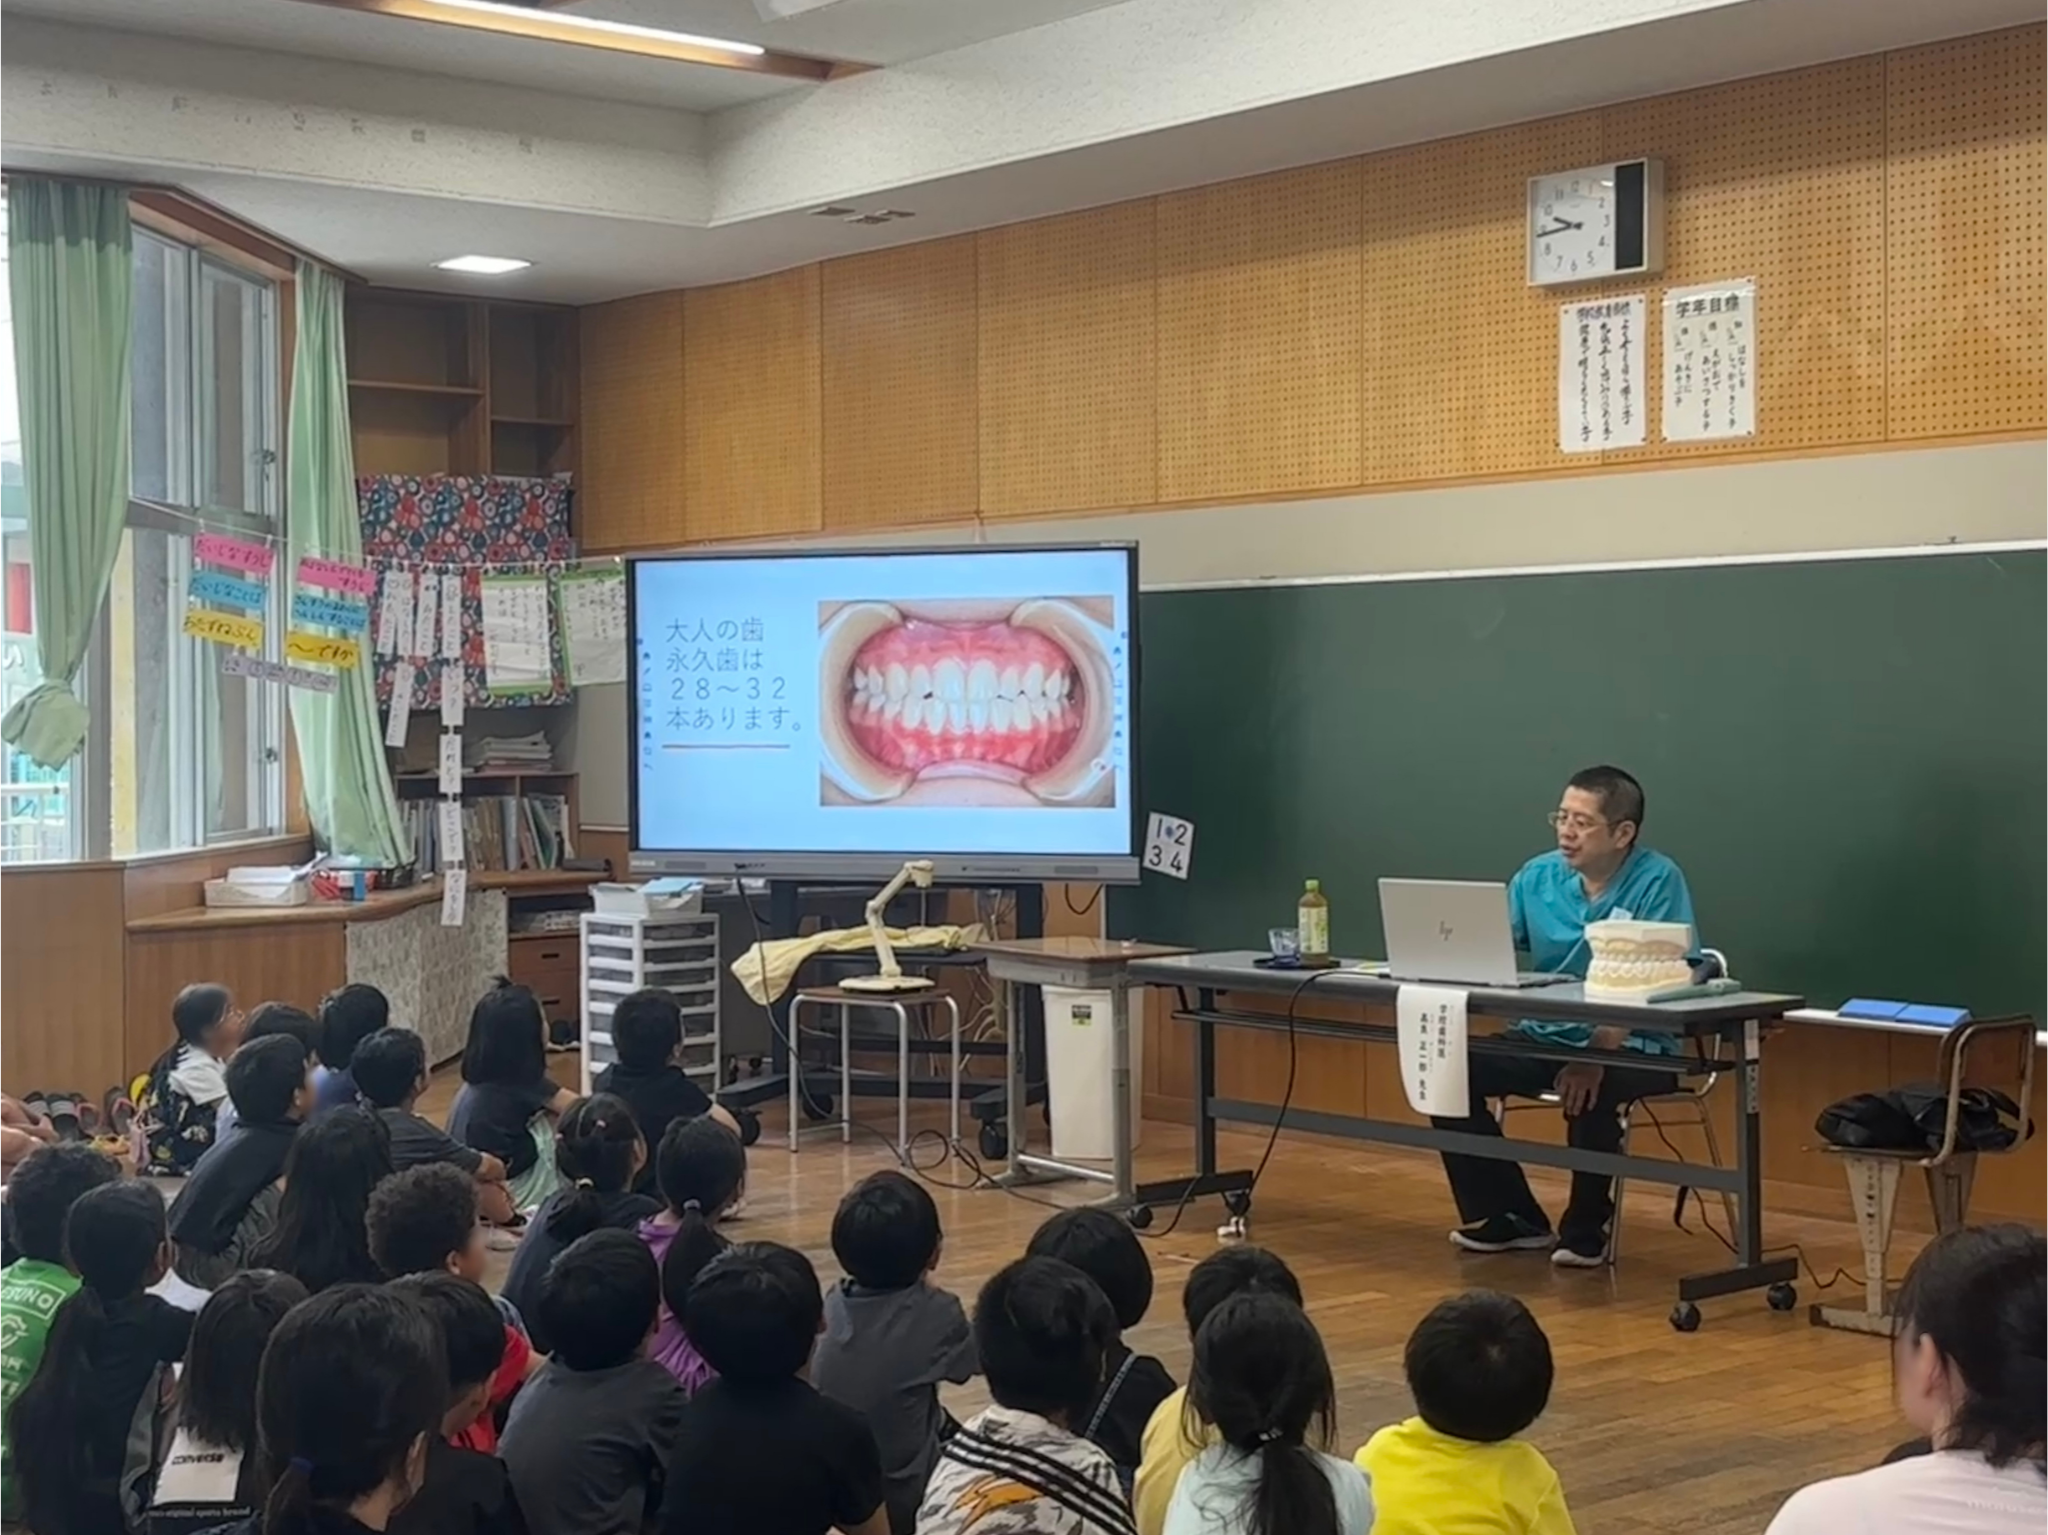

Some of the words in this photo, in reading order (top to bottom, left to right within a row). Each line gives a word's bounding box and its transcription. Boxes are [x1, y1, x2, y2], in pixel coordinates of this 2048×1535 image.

[1555, 187, 1564, 201] 11
[1570, 180, 1580, 193] 12
[1598, 197, 1606, 209] 2
[1603, 214, 1610, 227] 3
[1543, 243, 1552, 256] 8
[1598, 236, 1606, 247] 4
[1556, 256, 1564, 268] 7
[1570, 258, 1578, 272] 6
[1587, 250, 1595, 264] 5
[1675, 292, 1740, 318] 学年目標
[1702, 355, 1712, 431] あいさつする子
[665, 616, 764, 643] 大人の歯
[666, 647, 763, 673] 永久歯は
[666, 706, 801, 732] 本あります。
[1156, 818, 1163, 838] 1
[1174, 824, 1188, 846] 2
[1149, 845, 1163, 867] 3
[1170, 851, 1184, 872] 4
[1439, 920, 1454, 942] hp
[1418, 1079, 1428, 1100] 先生
